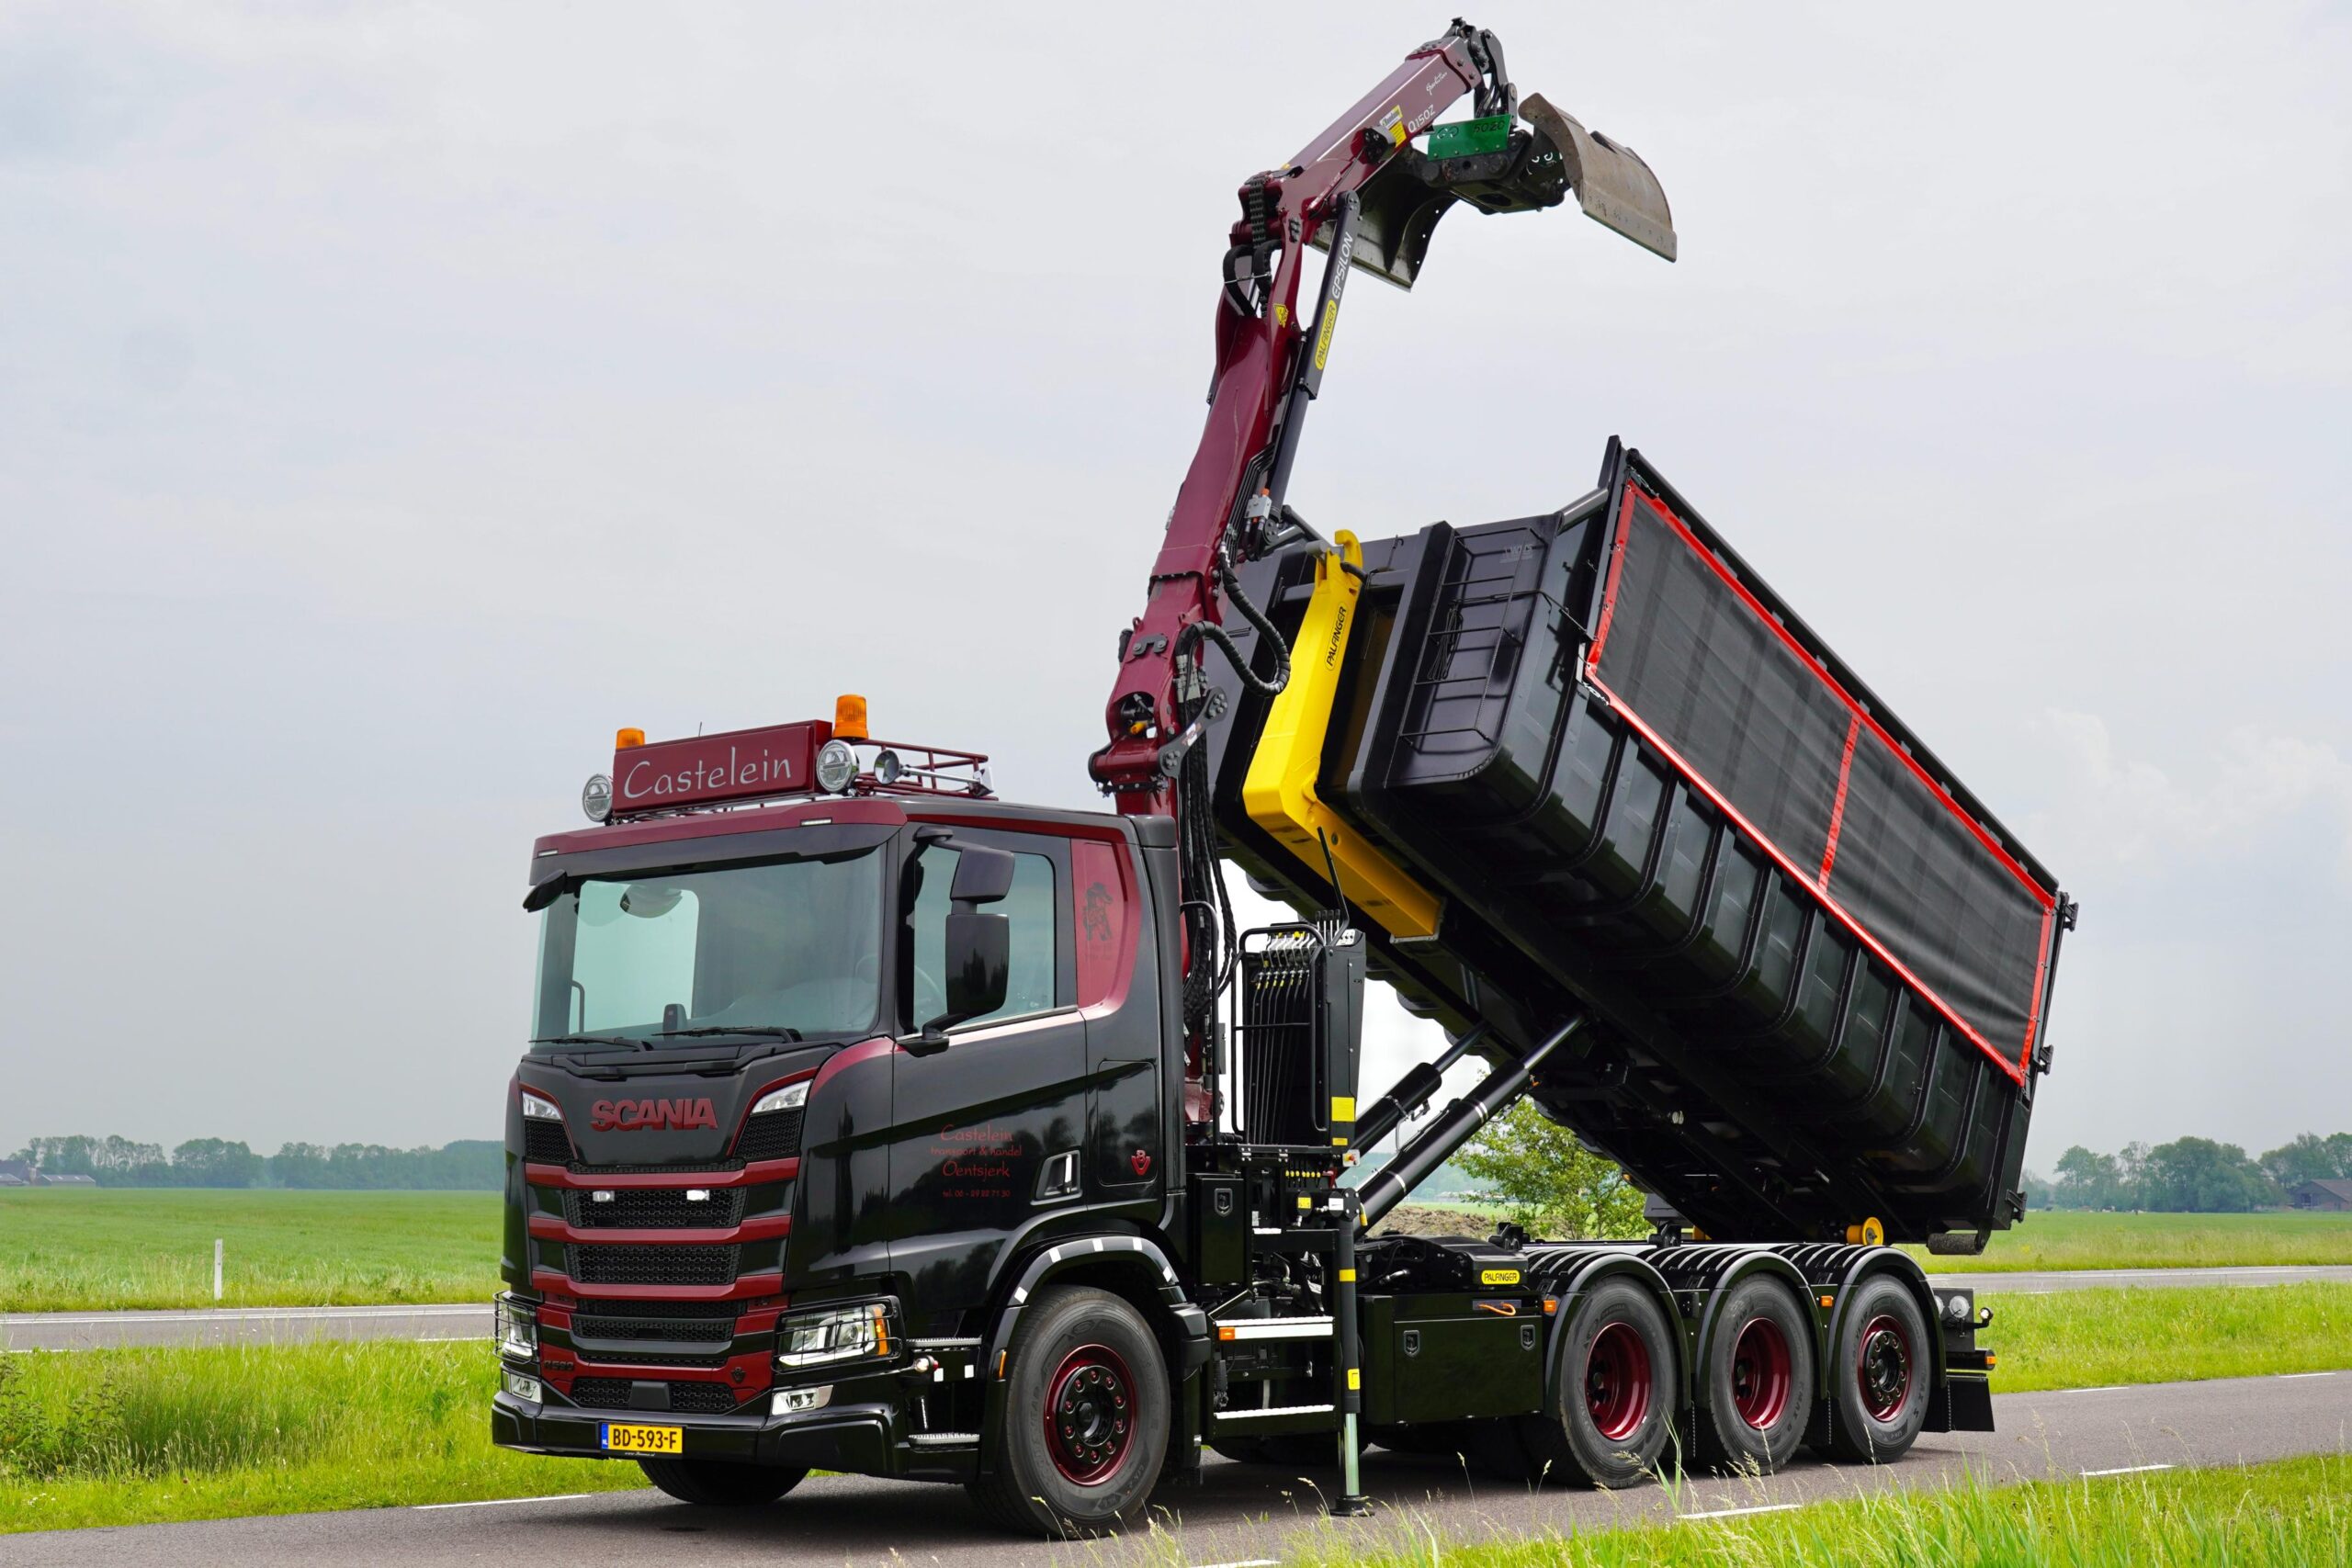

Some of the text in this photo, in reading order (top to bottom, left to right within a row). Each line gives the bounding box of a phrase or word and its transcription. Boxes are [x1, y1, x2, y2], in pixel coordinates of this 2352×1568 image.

[1408, 104, 1436, 133] Q150Z
[1474, 120, 1505, 133] 5020
[1317, 231, 1353, 367] PALFINGER EPSILON
[1327, 606, 1347, 667] PALFINGER
[624, 746, 791, 798] Castelein
[590, 1098, 718, 1132] SCANIA
[941, 1123, 1013, 1142] Castelein
[930, 1145, 1022, 1156] transport & handel
[942, 1160, 1010, 1182] Oentsjerk
[1484, 1273, 1518, 1281] PALFINGER
[613, 1427, 677, 1449] BD-593-F
